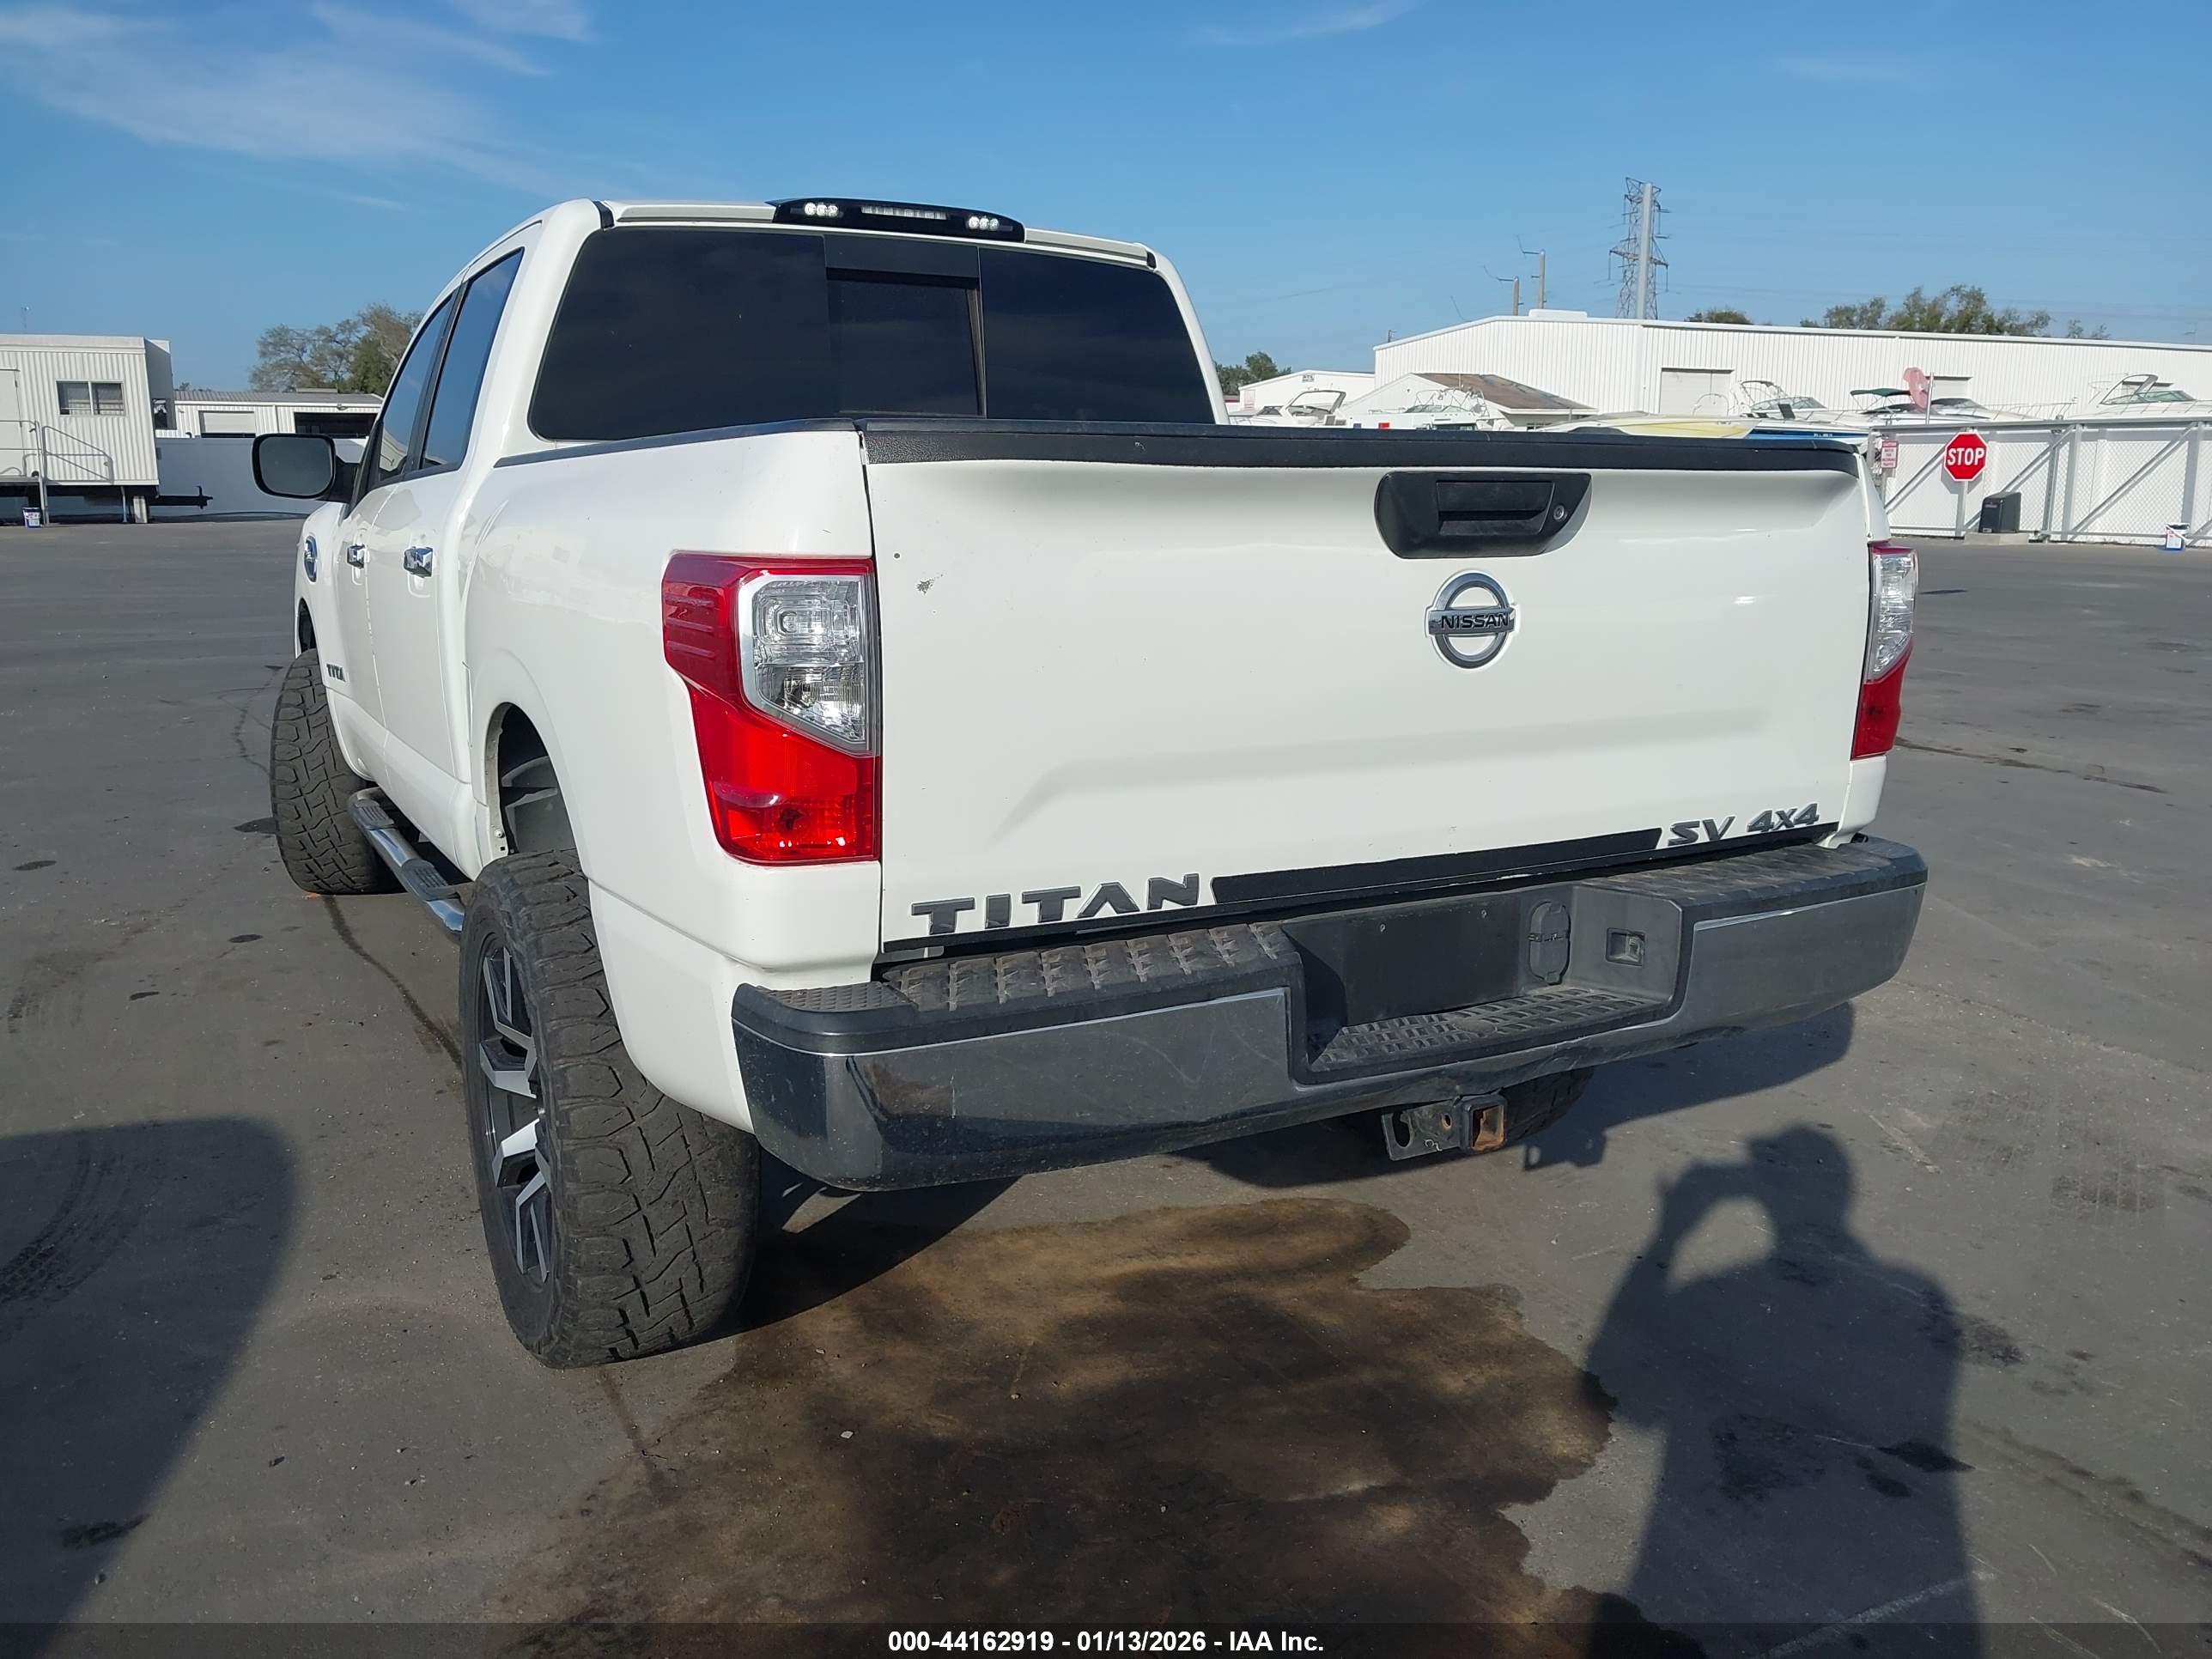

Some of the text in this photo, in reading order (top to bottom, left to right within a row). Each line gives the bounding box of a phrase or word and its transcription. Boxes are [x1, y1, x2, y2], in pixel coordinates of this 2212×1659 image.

[1947, 447, 1984, 465] STOP
[1441, 613, 1509, 629] NISSAN
[1668, 815, 1735, 847] SV
[911, 873, 1200, 935] TITAN
